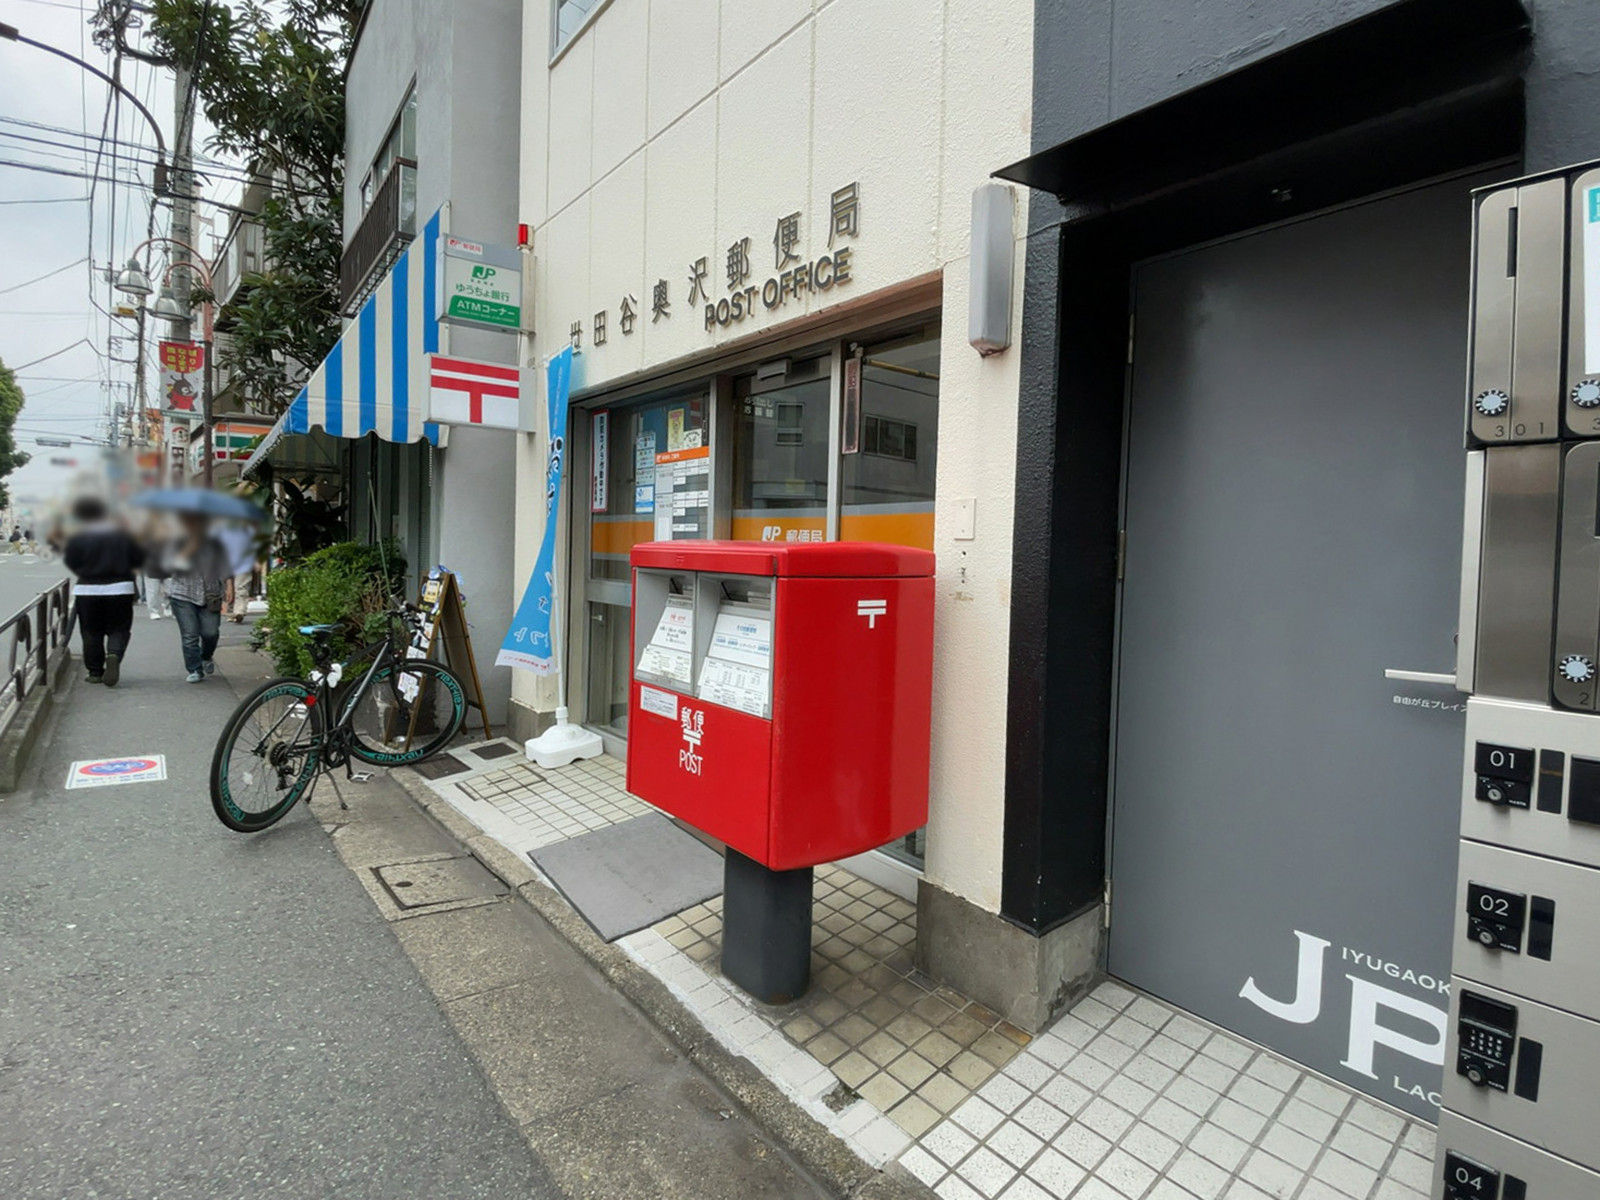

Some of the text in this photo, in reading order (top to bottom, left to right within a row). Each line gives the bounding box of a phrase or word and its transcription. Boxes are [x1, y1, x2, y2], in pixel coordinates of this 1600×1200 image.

[472, 265, 496, 279] JP
[456, 283, 510, 302] ゆうちょ銀行
[705, 247, 852, 332] POST OFFICE
[457, 300, 515, 316] ATMコーナー
[761, 526, 781, 541] JP
[786, 529, 823, 542] 郵便局
[681, 706, 704, 735] 郵便
[679, 749, 703, 776] POST
[1490, 750, 1515, 769] 01
[1480, 894, 1509, 917] 02
[1456, 1167, 1482, 1191] 04
